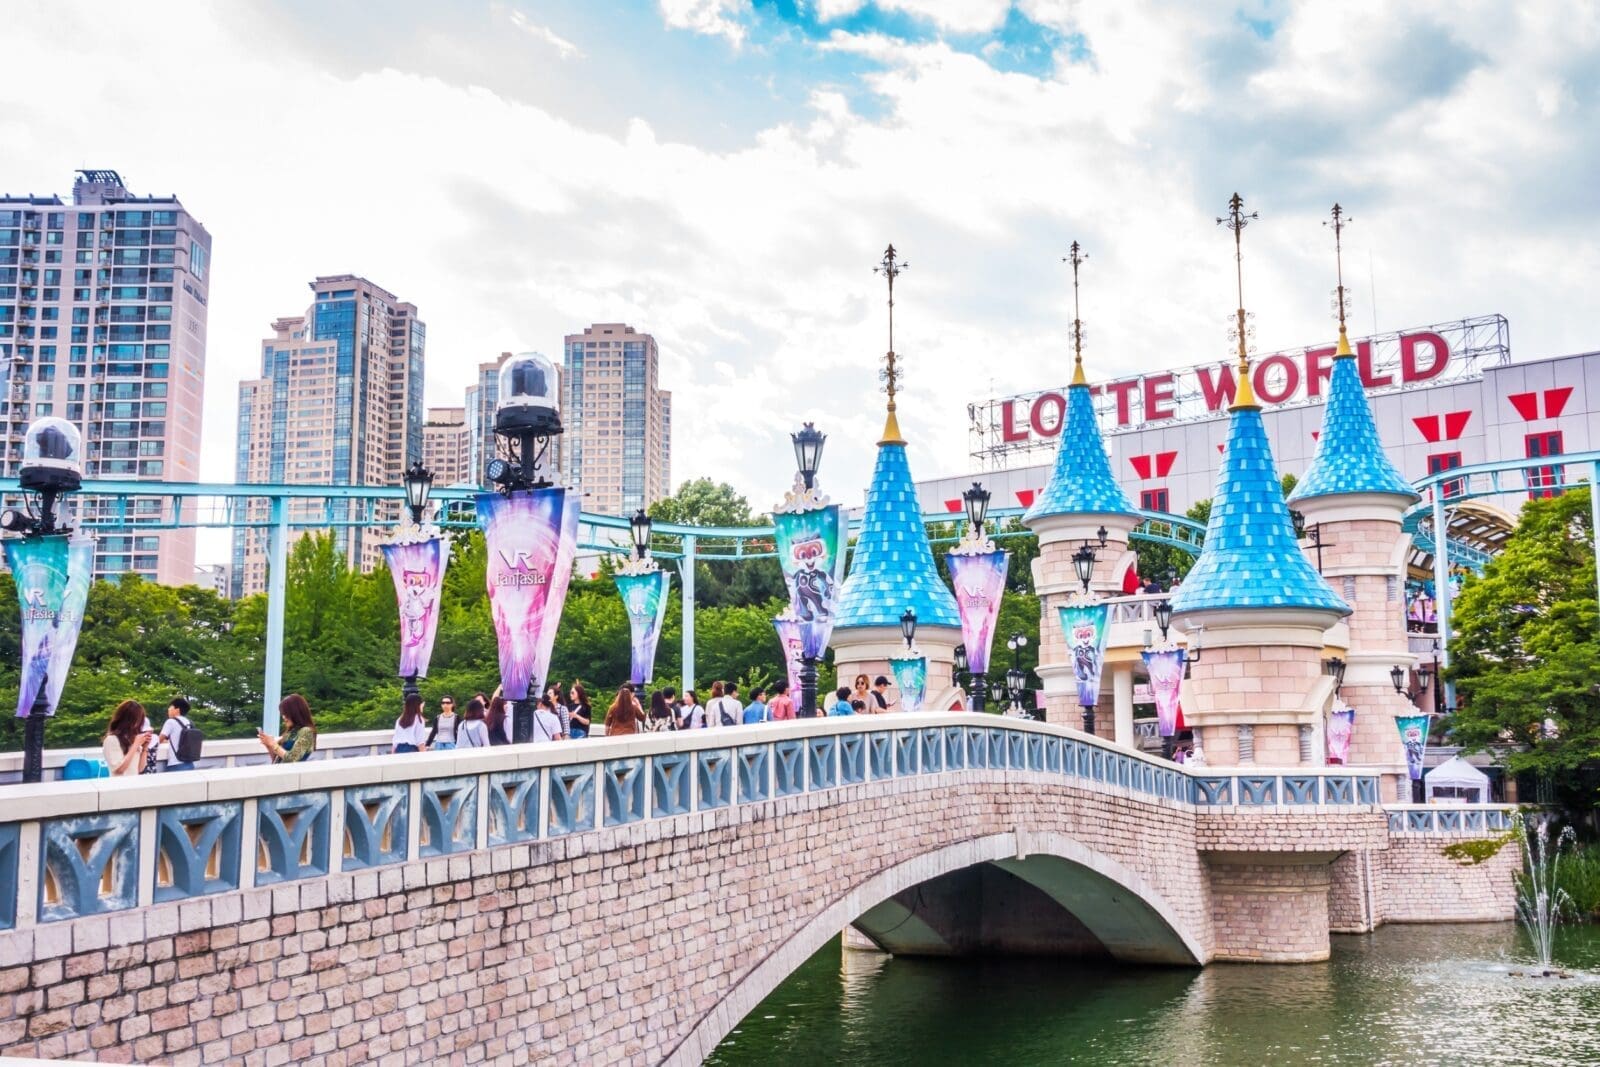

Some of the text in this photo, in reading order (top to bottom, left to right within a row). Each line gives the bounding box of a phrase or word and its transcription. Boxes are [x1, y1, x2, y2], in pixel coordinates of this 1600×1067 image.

[1002, 331, 1449, 442] LOTE WORLD
[499, 548, 538, 570] VR
